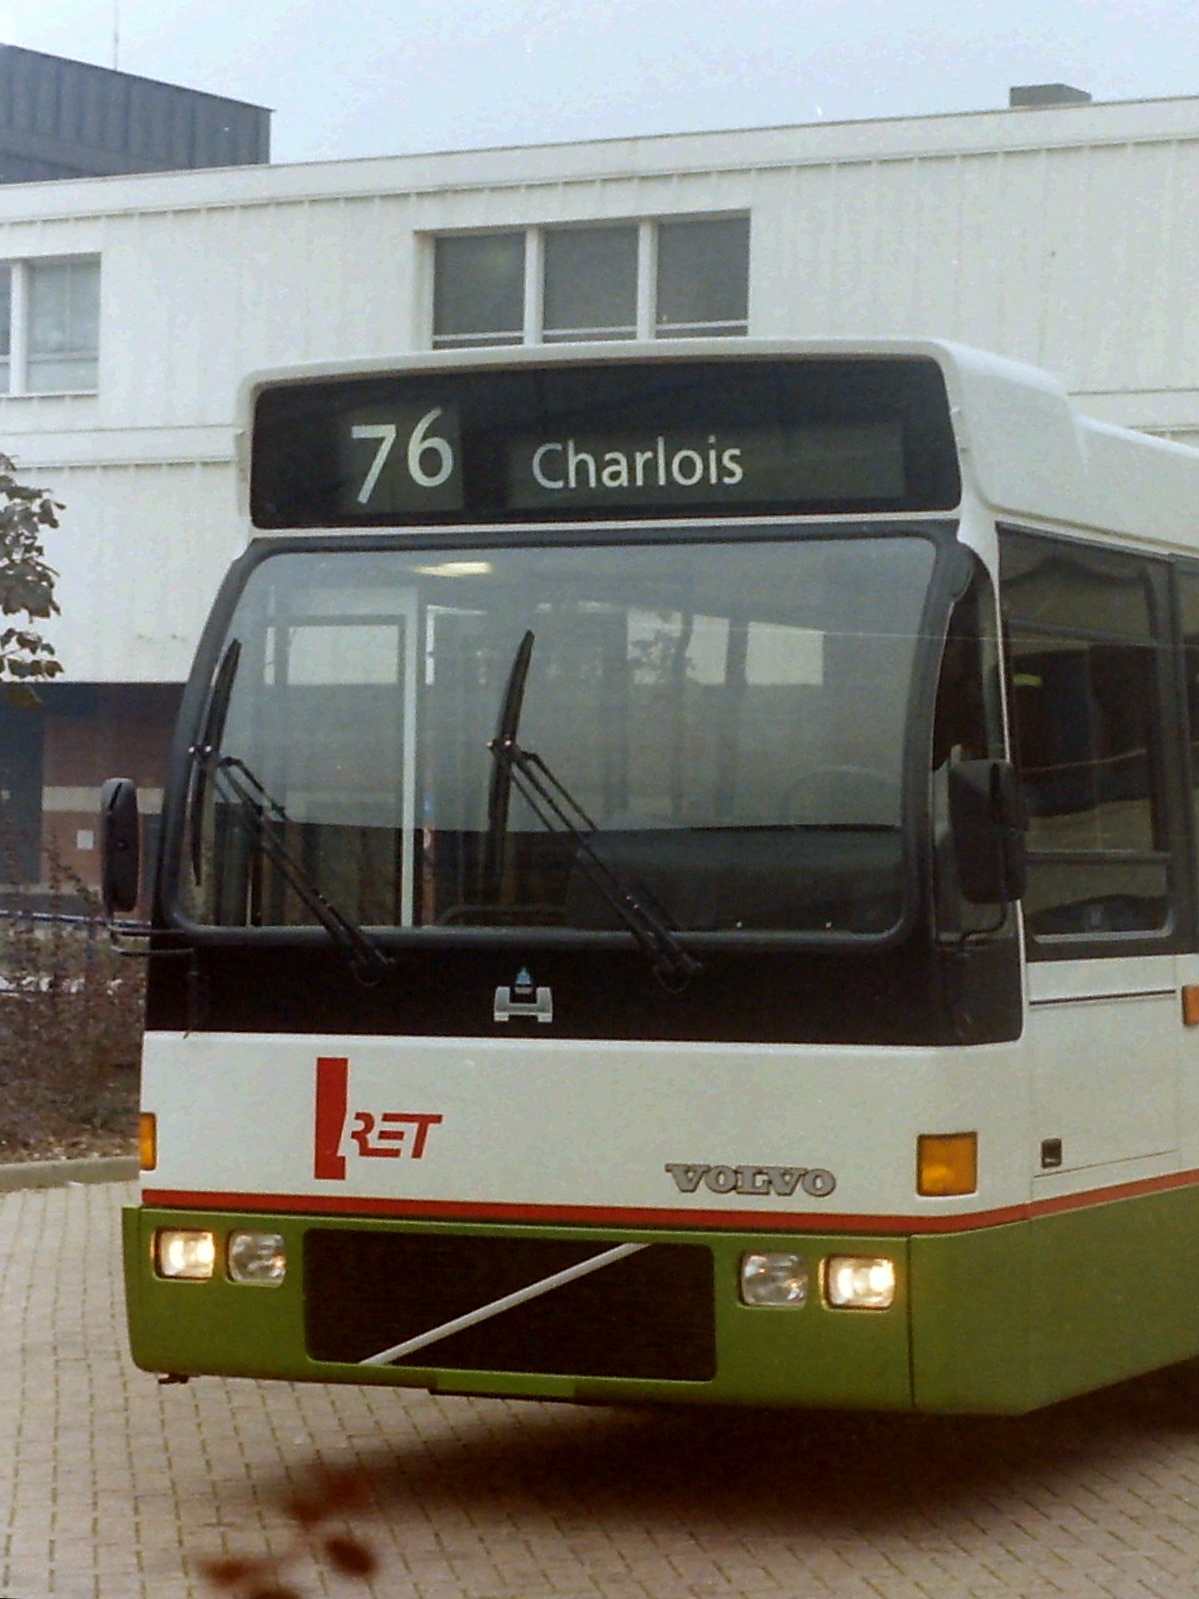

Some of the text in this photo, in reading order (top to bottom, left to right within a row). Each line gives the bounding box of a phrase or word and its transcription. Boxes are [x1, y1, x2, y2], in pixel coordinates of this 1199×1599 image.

[351, 406, 744, 504] 76 Charlois
[347, 1110, 443, 1160] RET
[664, 1163, 837, 1198] VOLVO
